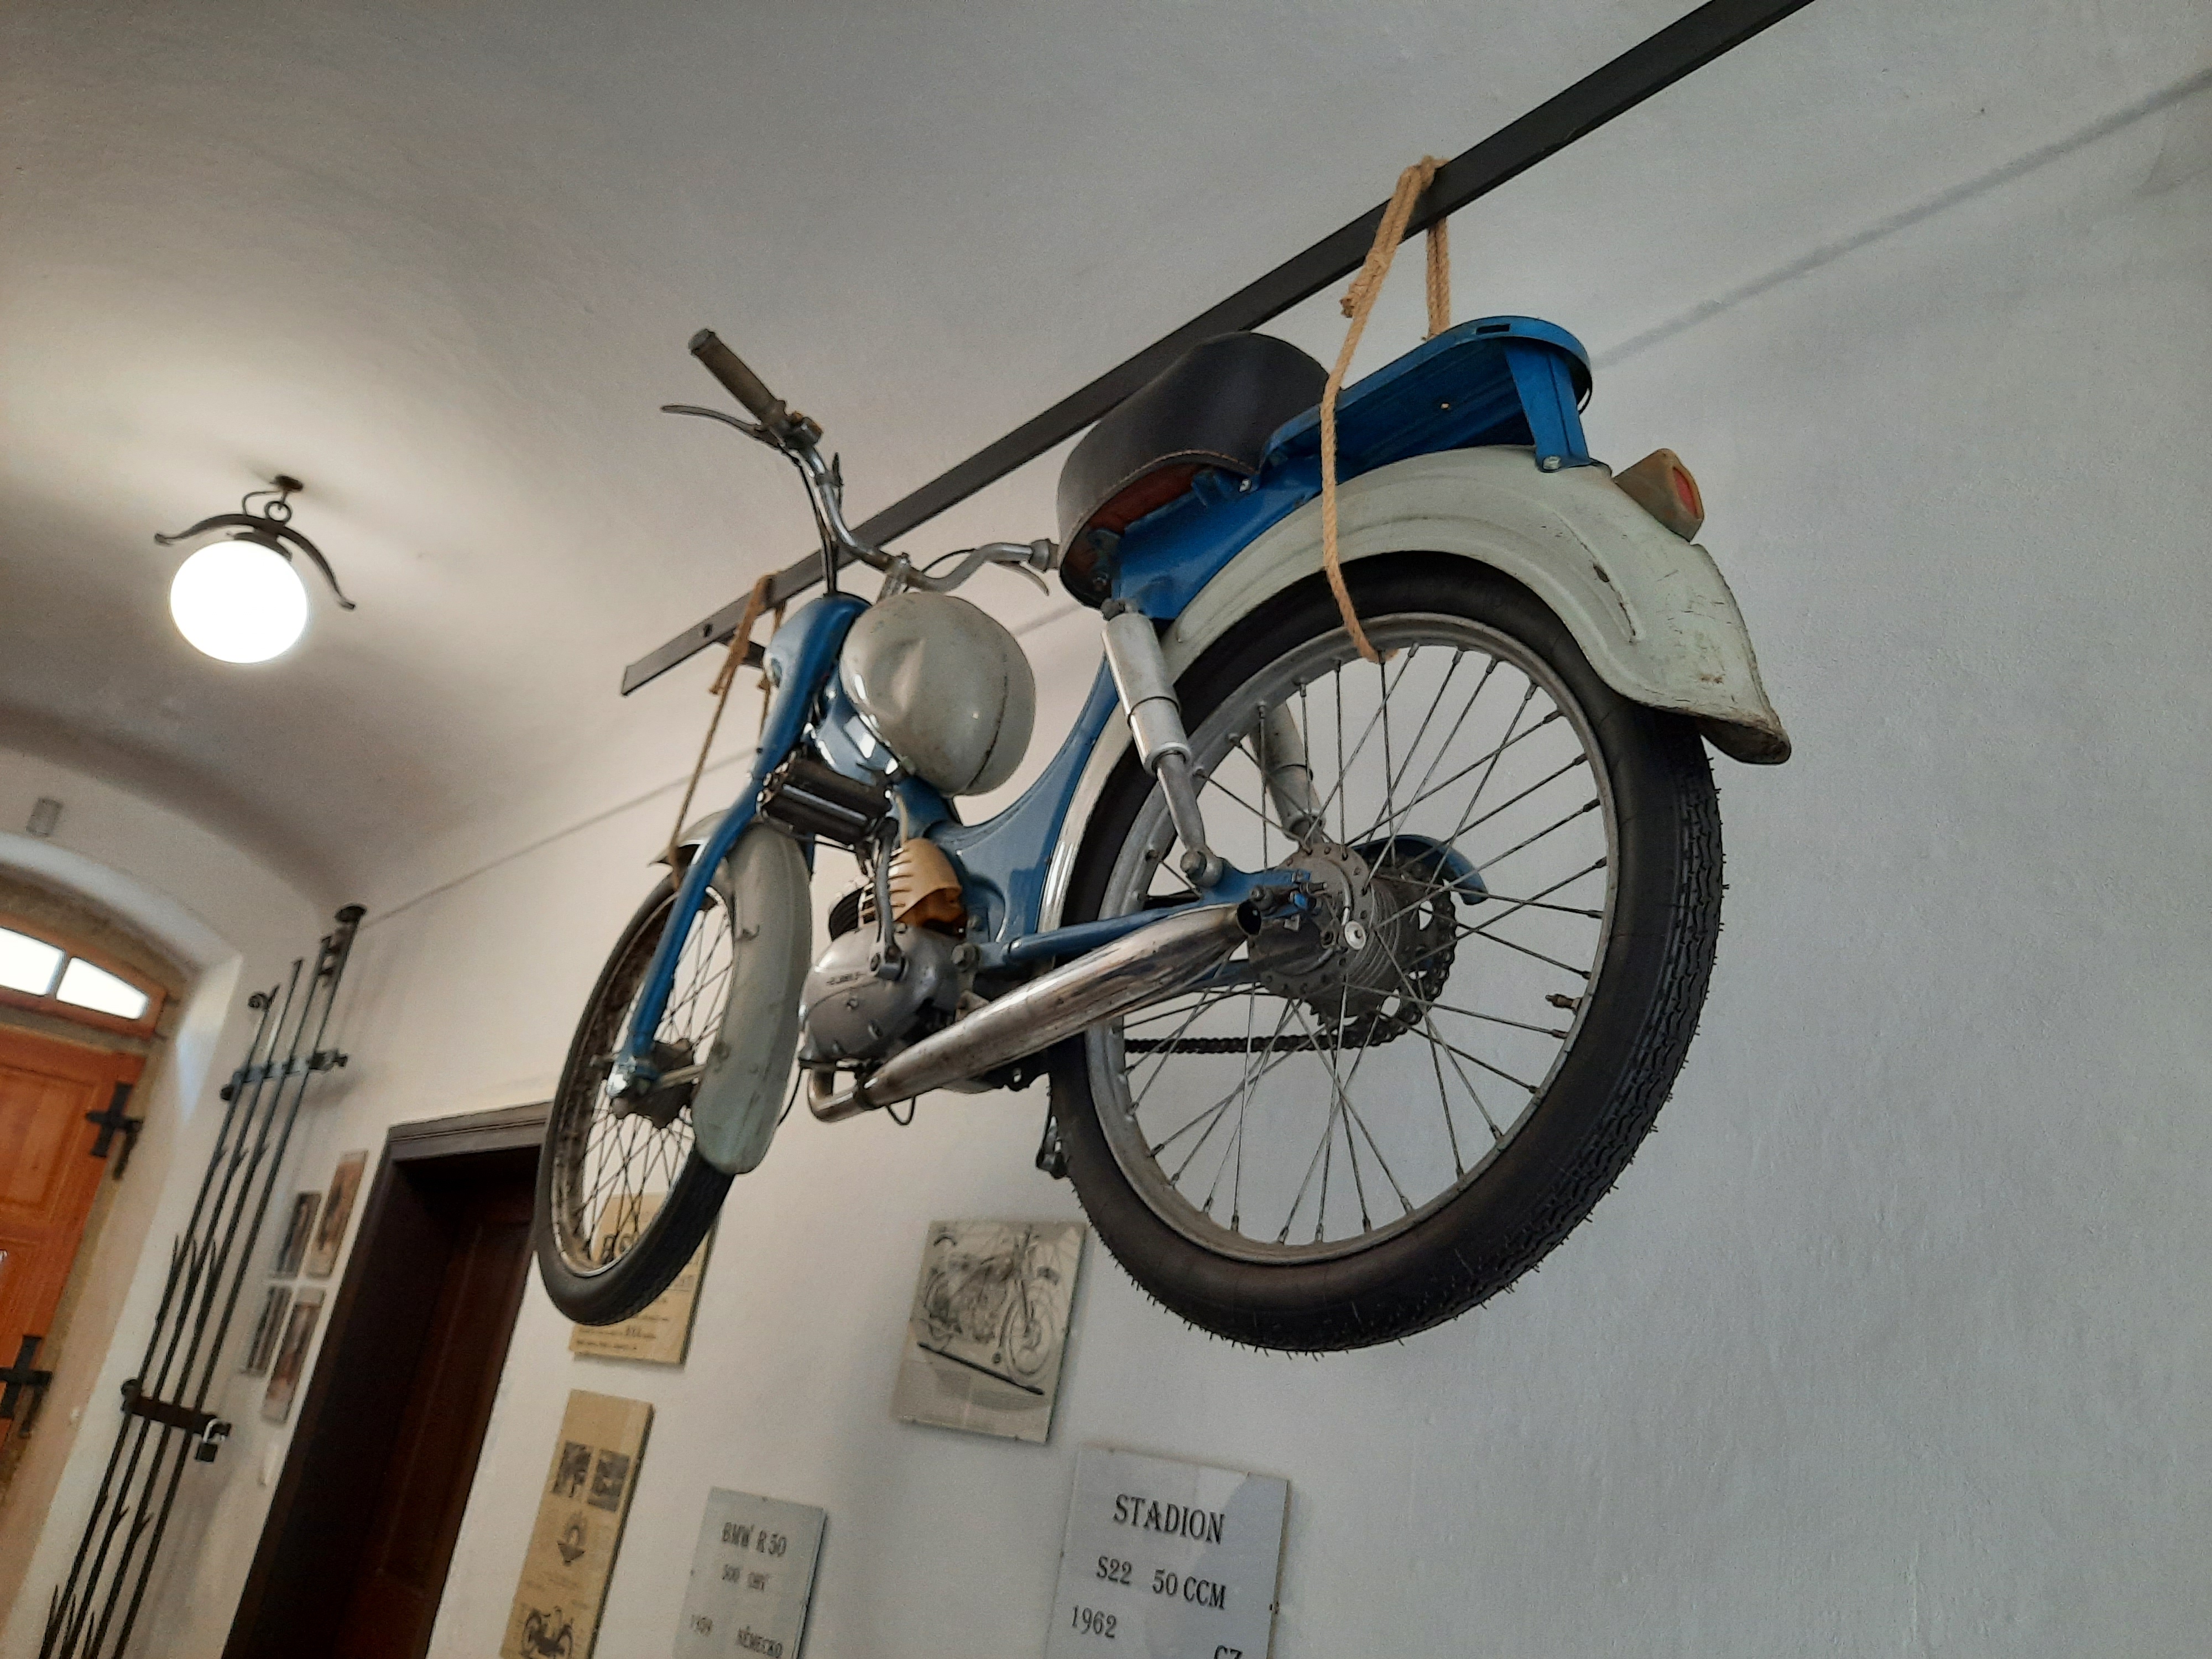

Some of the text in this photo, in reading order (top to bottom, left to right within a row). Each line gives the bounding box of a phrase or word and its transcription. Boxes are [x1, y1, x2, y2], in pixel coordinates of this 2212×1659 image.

[1113, 1493, 1225, 1545] STADION
[1096, 1556, 1227, 1610] S22 50 CCM
[1071, 1604, 1117, 1639] 1962
